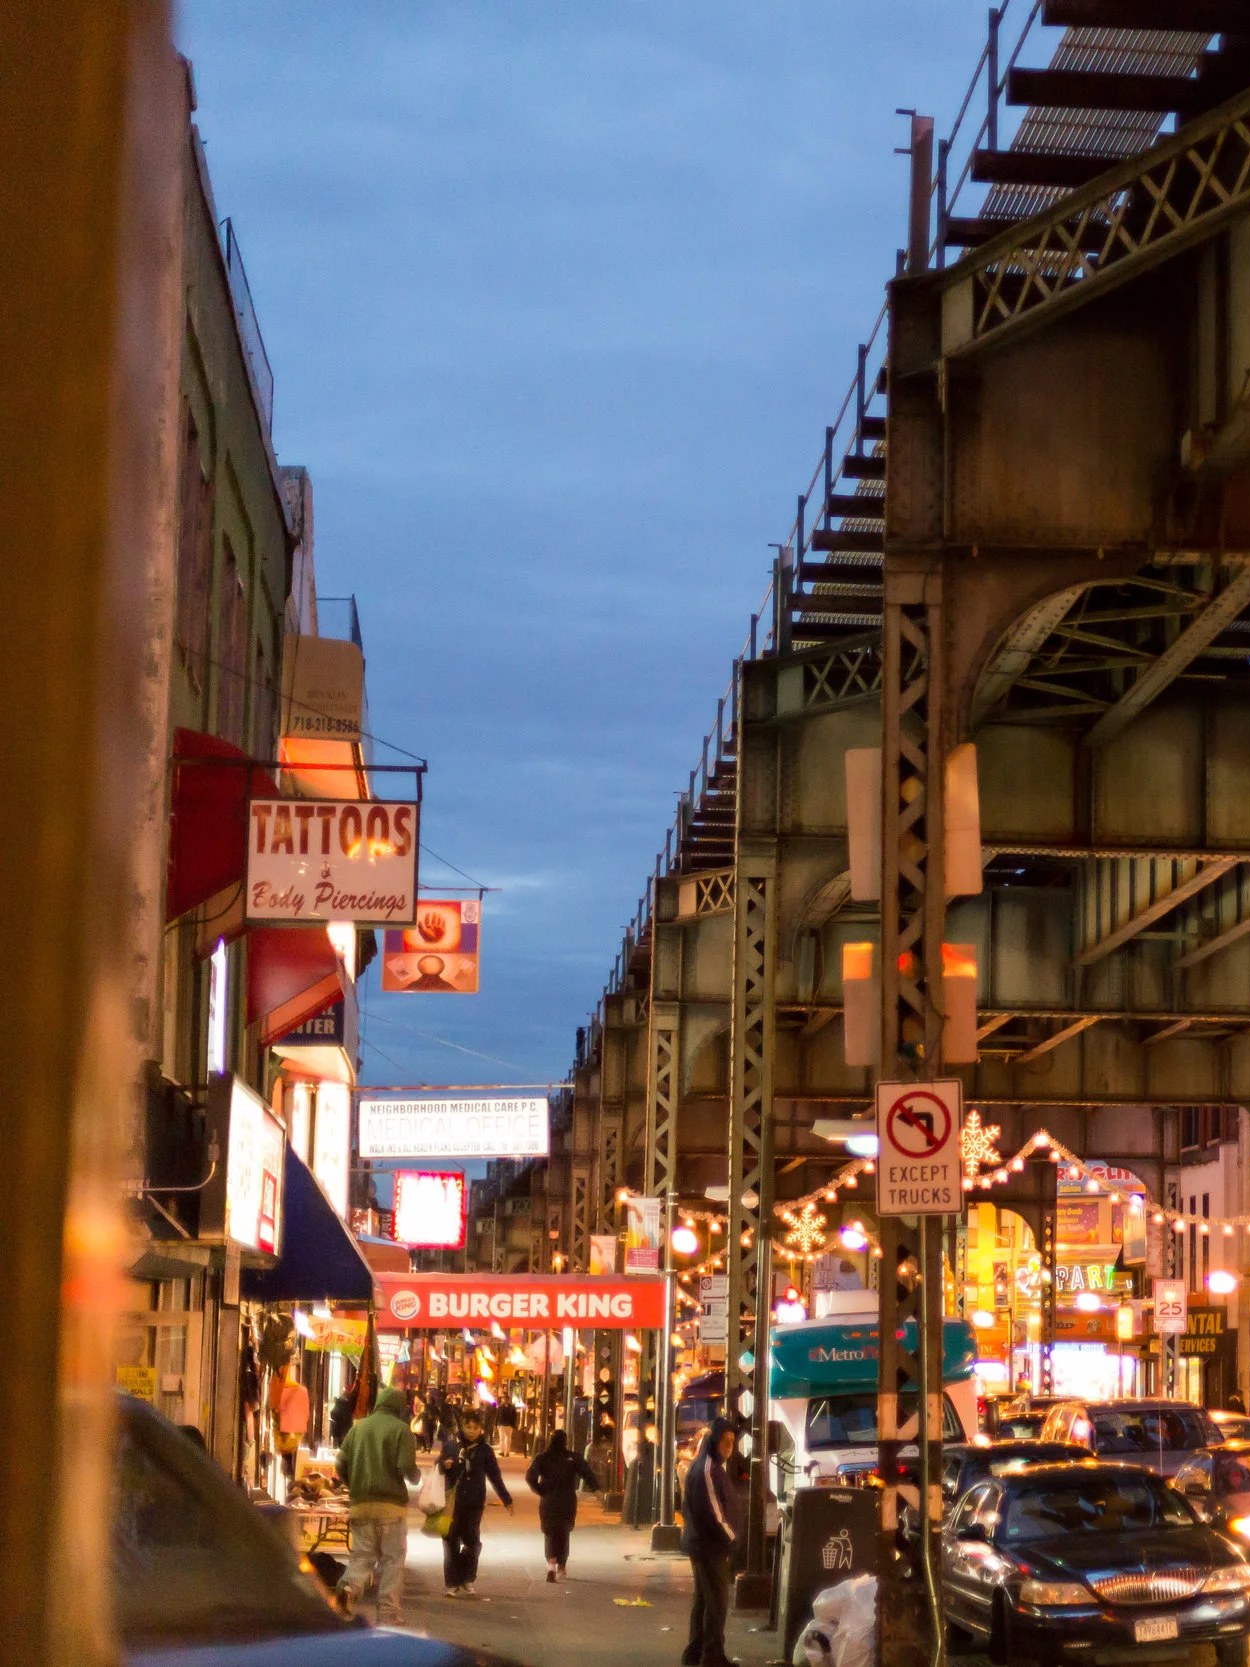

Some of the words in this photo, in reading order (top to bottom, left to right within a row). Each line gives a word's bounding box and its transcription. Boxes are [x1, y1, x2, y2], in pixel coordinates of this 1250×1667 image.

[252, 805, 411, 857] TATTOOS
[252, 881, 304, 916] Body
[314, 881, 408, 919] Piercings
[370, 1103, 447, 1115] NEIGHBORHOOD
[450, 1102, 492, 1113] MEDICAL
[494, 1101, 519, 1113] CARE
[367, 1116, 453, 1141] MEDICAL
[466, 1114, 540, 1138] OFFICE
[889, 1165, 949, 1182] EXCEPT
[889, 1188, 951, 1205] TRUCKS
[1056, 1265, 1116, 1290] PART
[429, 1293, 549, 1318] BURGER
[557, 1293, 632, 1318] KING
[1159, 1301, 1182, 1315] 25
[1179, 1338, 1217, 1354] ERVICES
